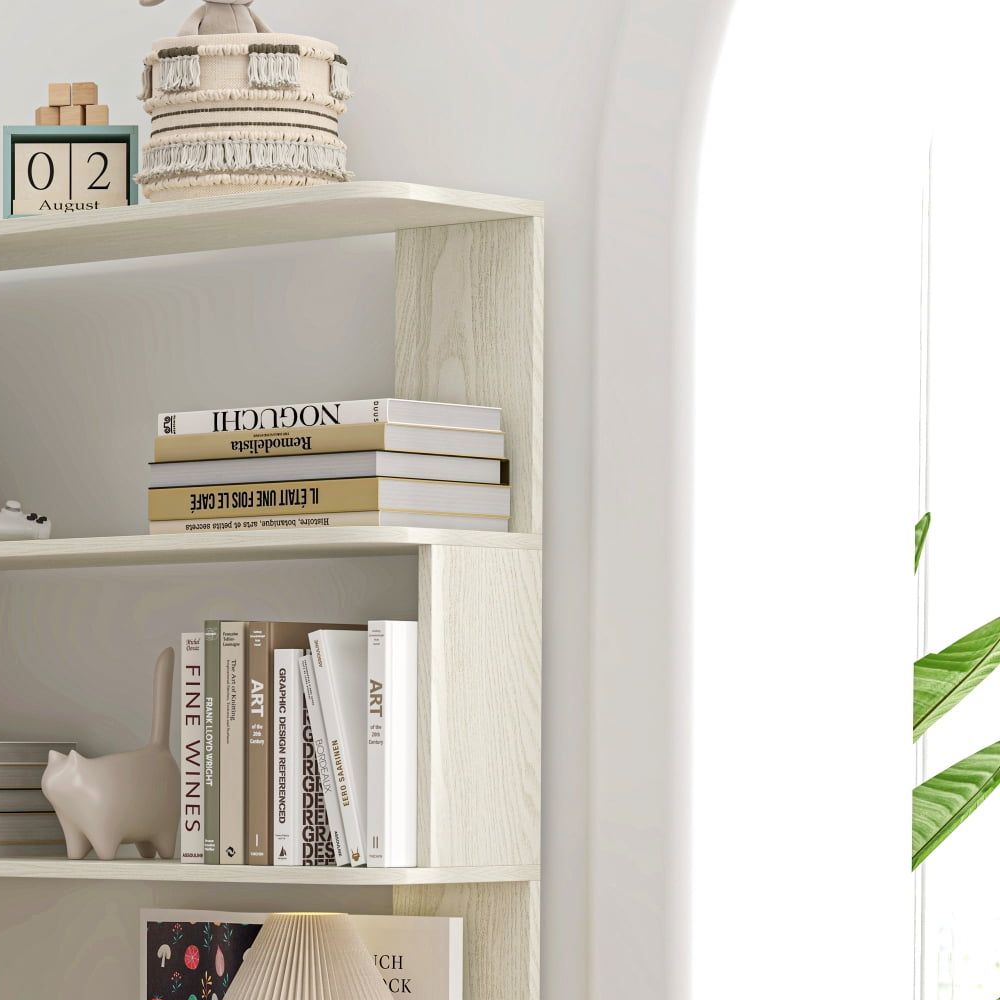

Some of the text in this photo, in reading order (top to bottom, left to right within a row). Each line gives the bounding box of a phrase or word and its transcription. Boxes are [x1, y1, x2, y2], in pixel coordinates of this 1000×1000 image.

[27, 151, 111, 191] 0 2
[39, 199, 100, 213] August
[212, 403, 341, 433] NOGUCHI
[231, 436, 312, 454] Remodelista
[190, 487, 319, 514] IL ÉTAIT UNE FOIS LE CAFÉ
[250, 679, 264, 718] ART
[278, 668, 287, 714] GRAPHIC
[369, 679, 383, 718] ART
[185, 665, 201, 832] FINE WINES
[205, 697, 213, 787] FRANK LLOYD WRIGHT
[278, 717, 287, 754] DESIGN
[278, 757, 287, 824] REFERENCED
[331, 740, 350, 807] EERO SAARINEN
